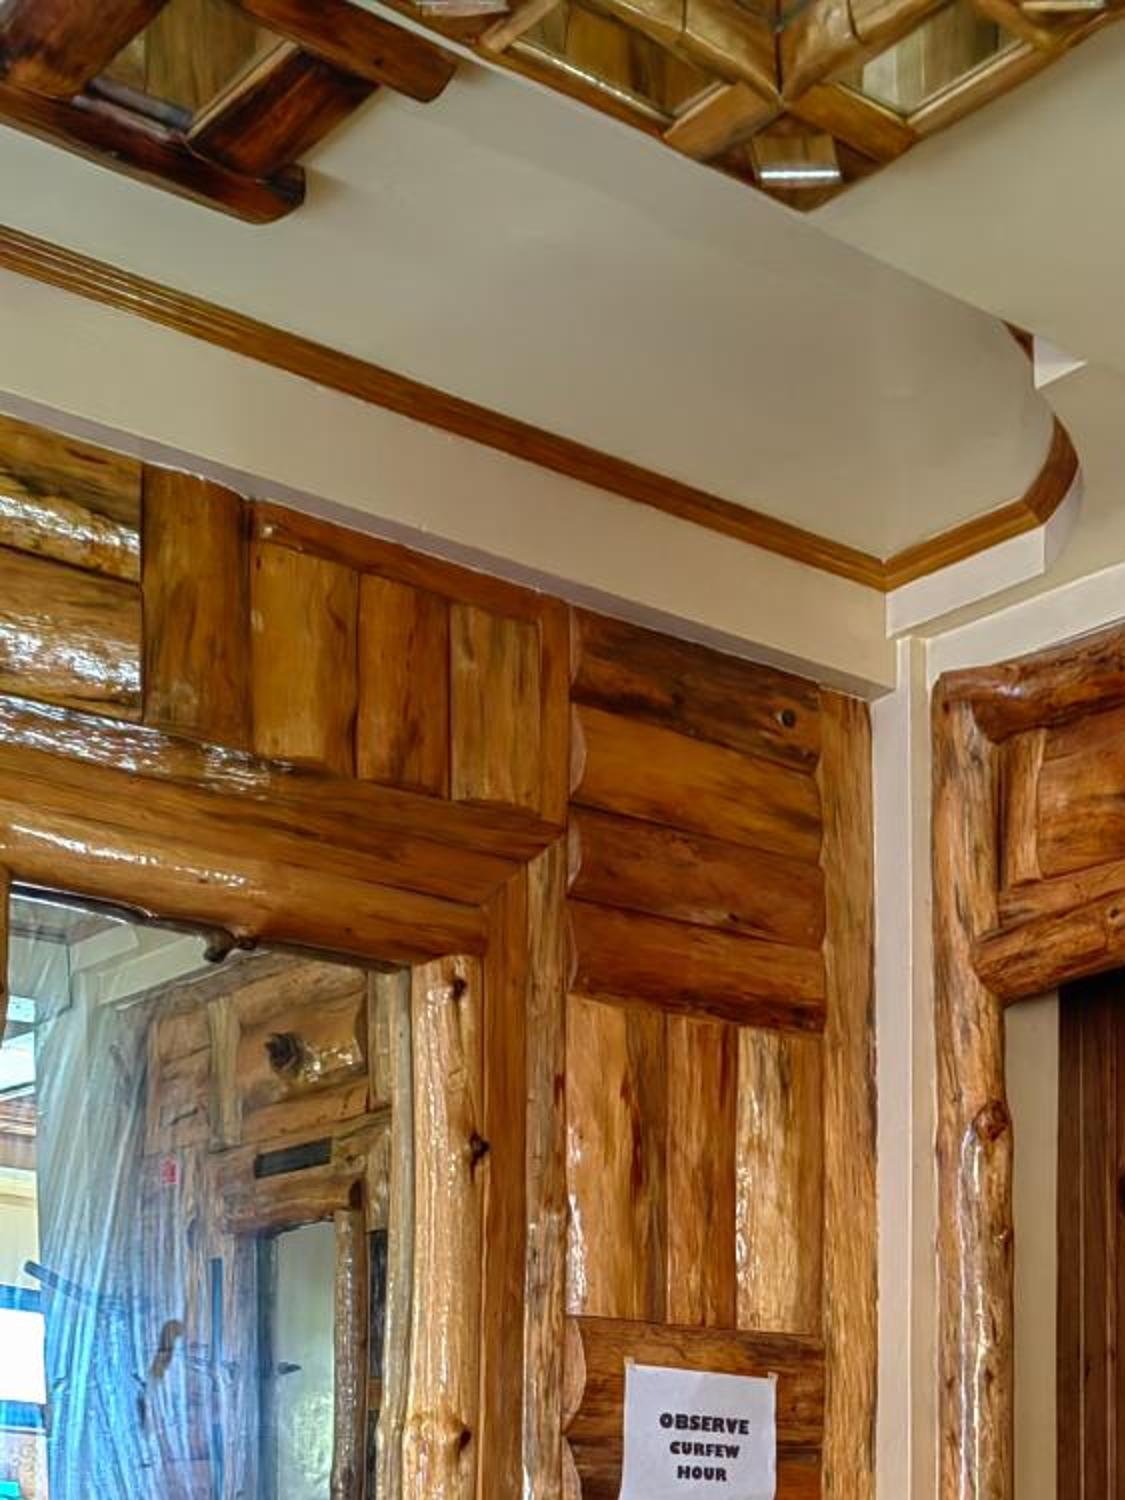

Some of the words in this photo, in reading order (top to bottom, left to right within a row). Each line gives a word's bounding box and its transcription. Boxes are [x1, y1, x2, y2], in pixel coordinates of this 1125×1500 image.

[659, 1412, 750, 1435] OBSERVE
[669, 1441, 740, 1459] CURFEW
[677, 1465, 727, 1482] HOUR
